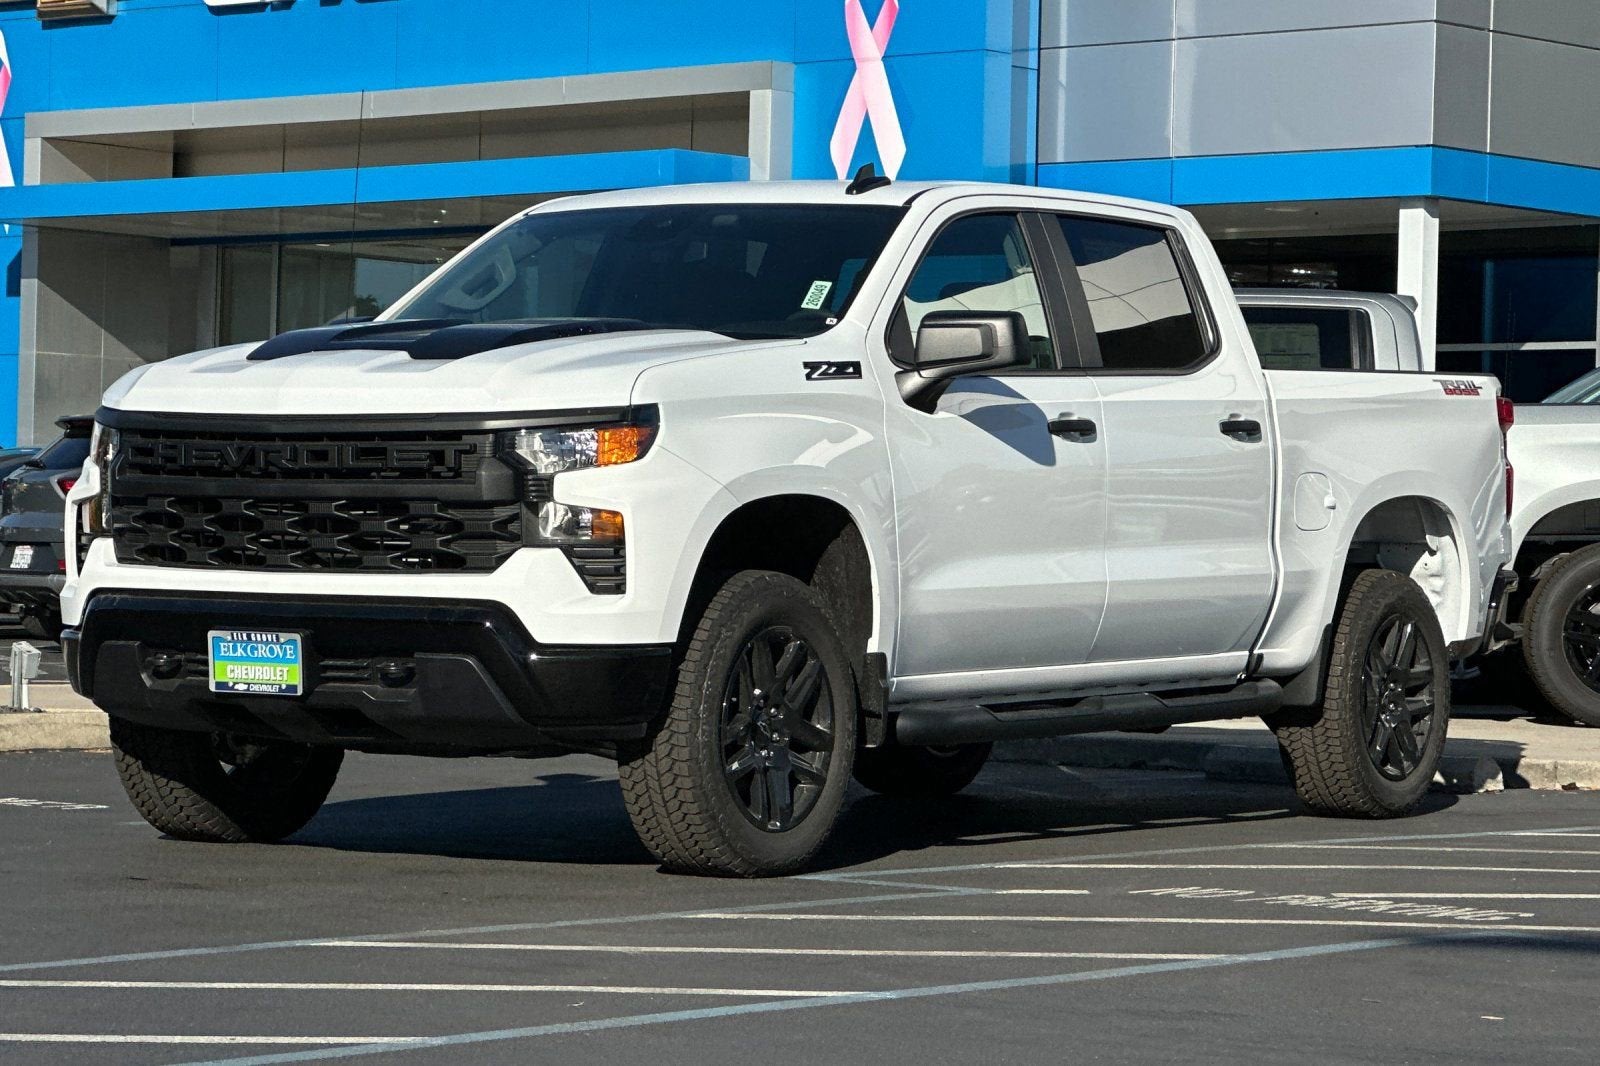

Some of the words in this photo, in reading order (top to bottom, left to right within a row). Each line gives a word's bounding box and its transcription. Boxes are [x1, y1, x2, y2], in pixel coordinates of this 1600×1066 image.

[805, 284, 828, 307] 260049
[1432, 379, 1483, 389] TRAIL
[1444, 388, 1480, 396] BOSS
[126, 440, 478, 474] CHEVROLET
[233, 632, 248, 641] ELK
[250, 633, 278, 643] GROVE
[219, 642, 247, 657] ELK
[247, 643, 296, 659] GROVE
[226, 664, 289, 682] CHEVROLET
[249, 683, 280, 693] CHEVROLET
